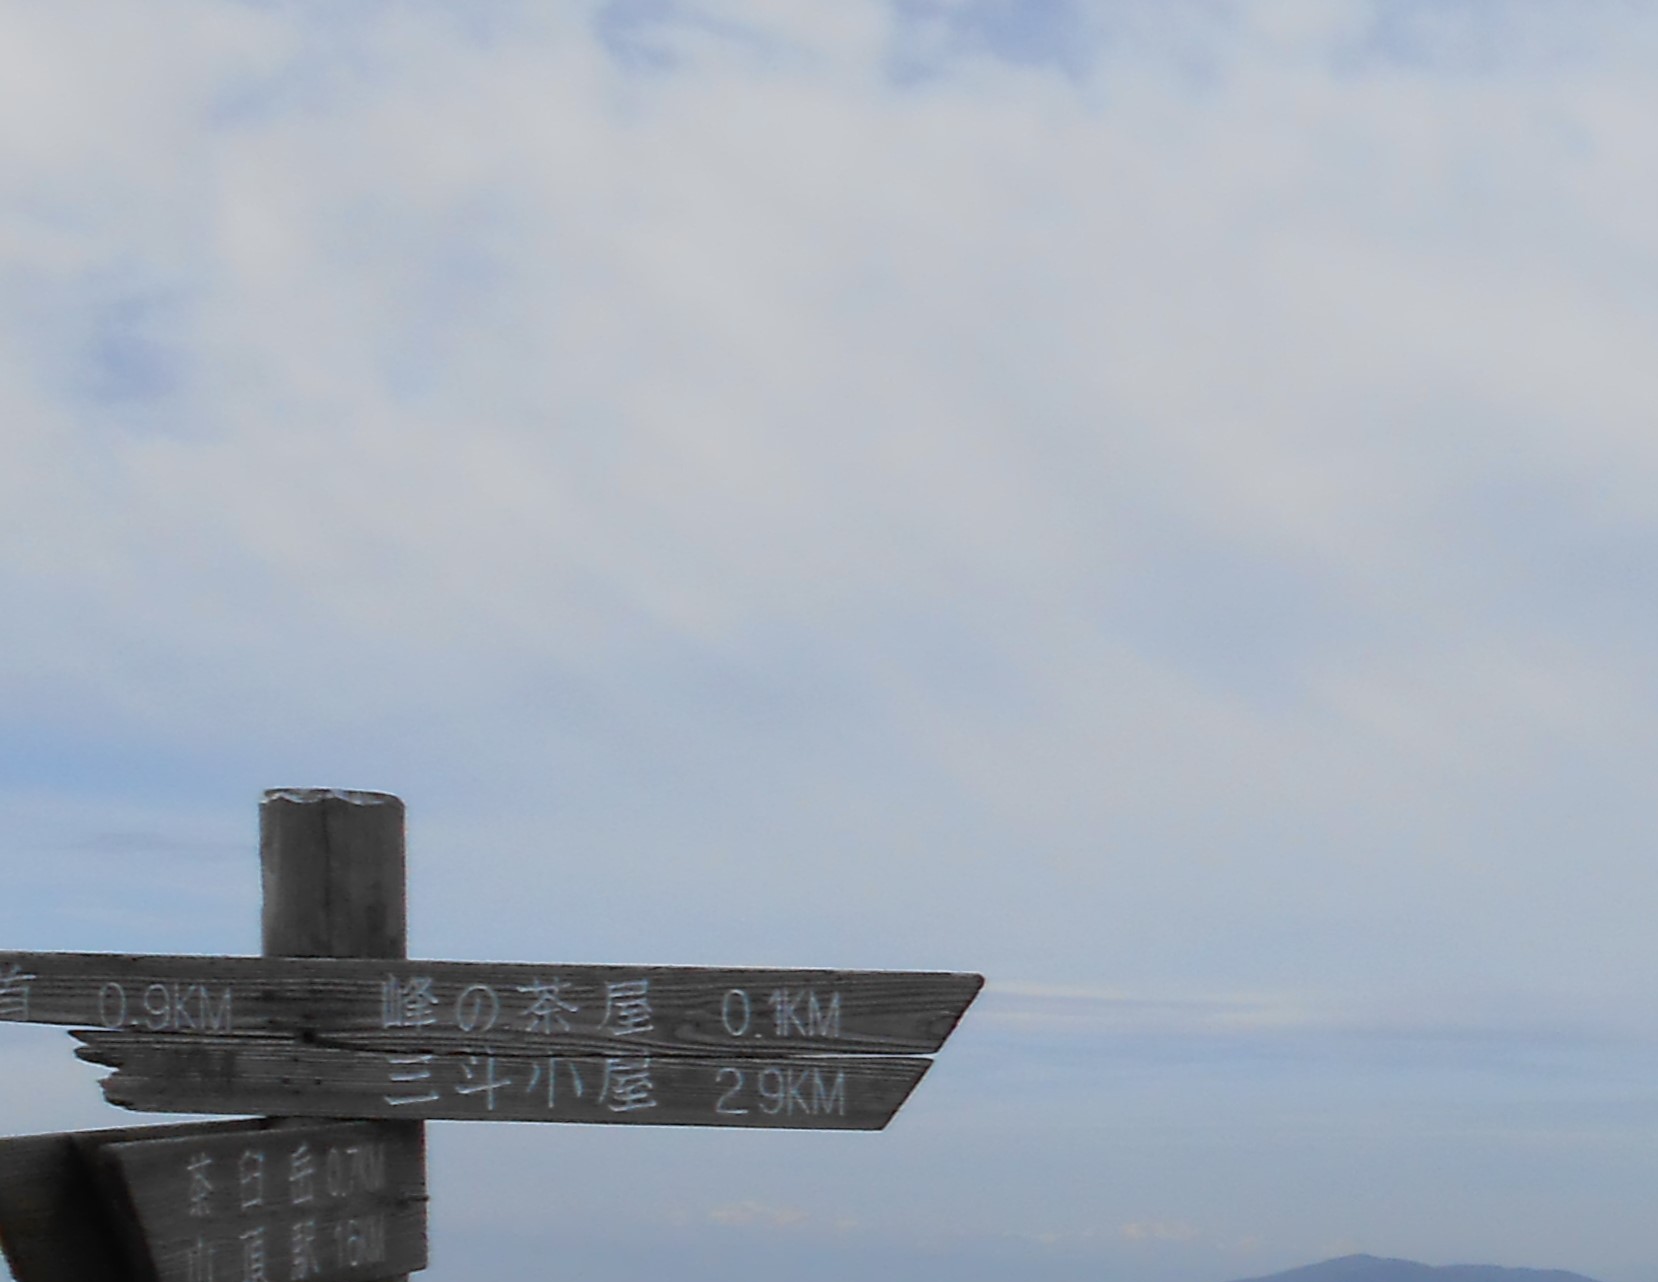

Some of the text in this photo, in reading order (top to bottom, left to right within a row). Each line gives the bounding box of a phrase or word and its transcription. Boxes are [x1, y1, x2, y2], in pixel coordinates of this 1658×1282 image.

[97, 981, 234, 1033] 0.9KM
[380, 972, 842, 1039] 峰の茶屋 0.1KM
[383, 1045, 658, 1113] 三斗小屋
